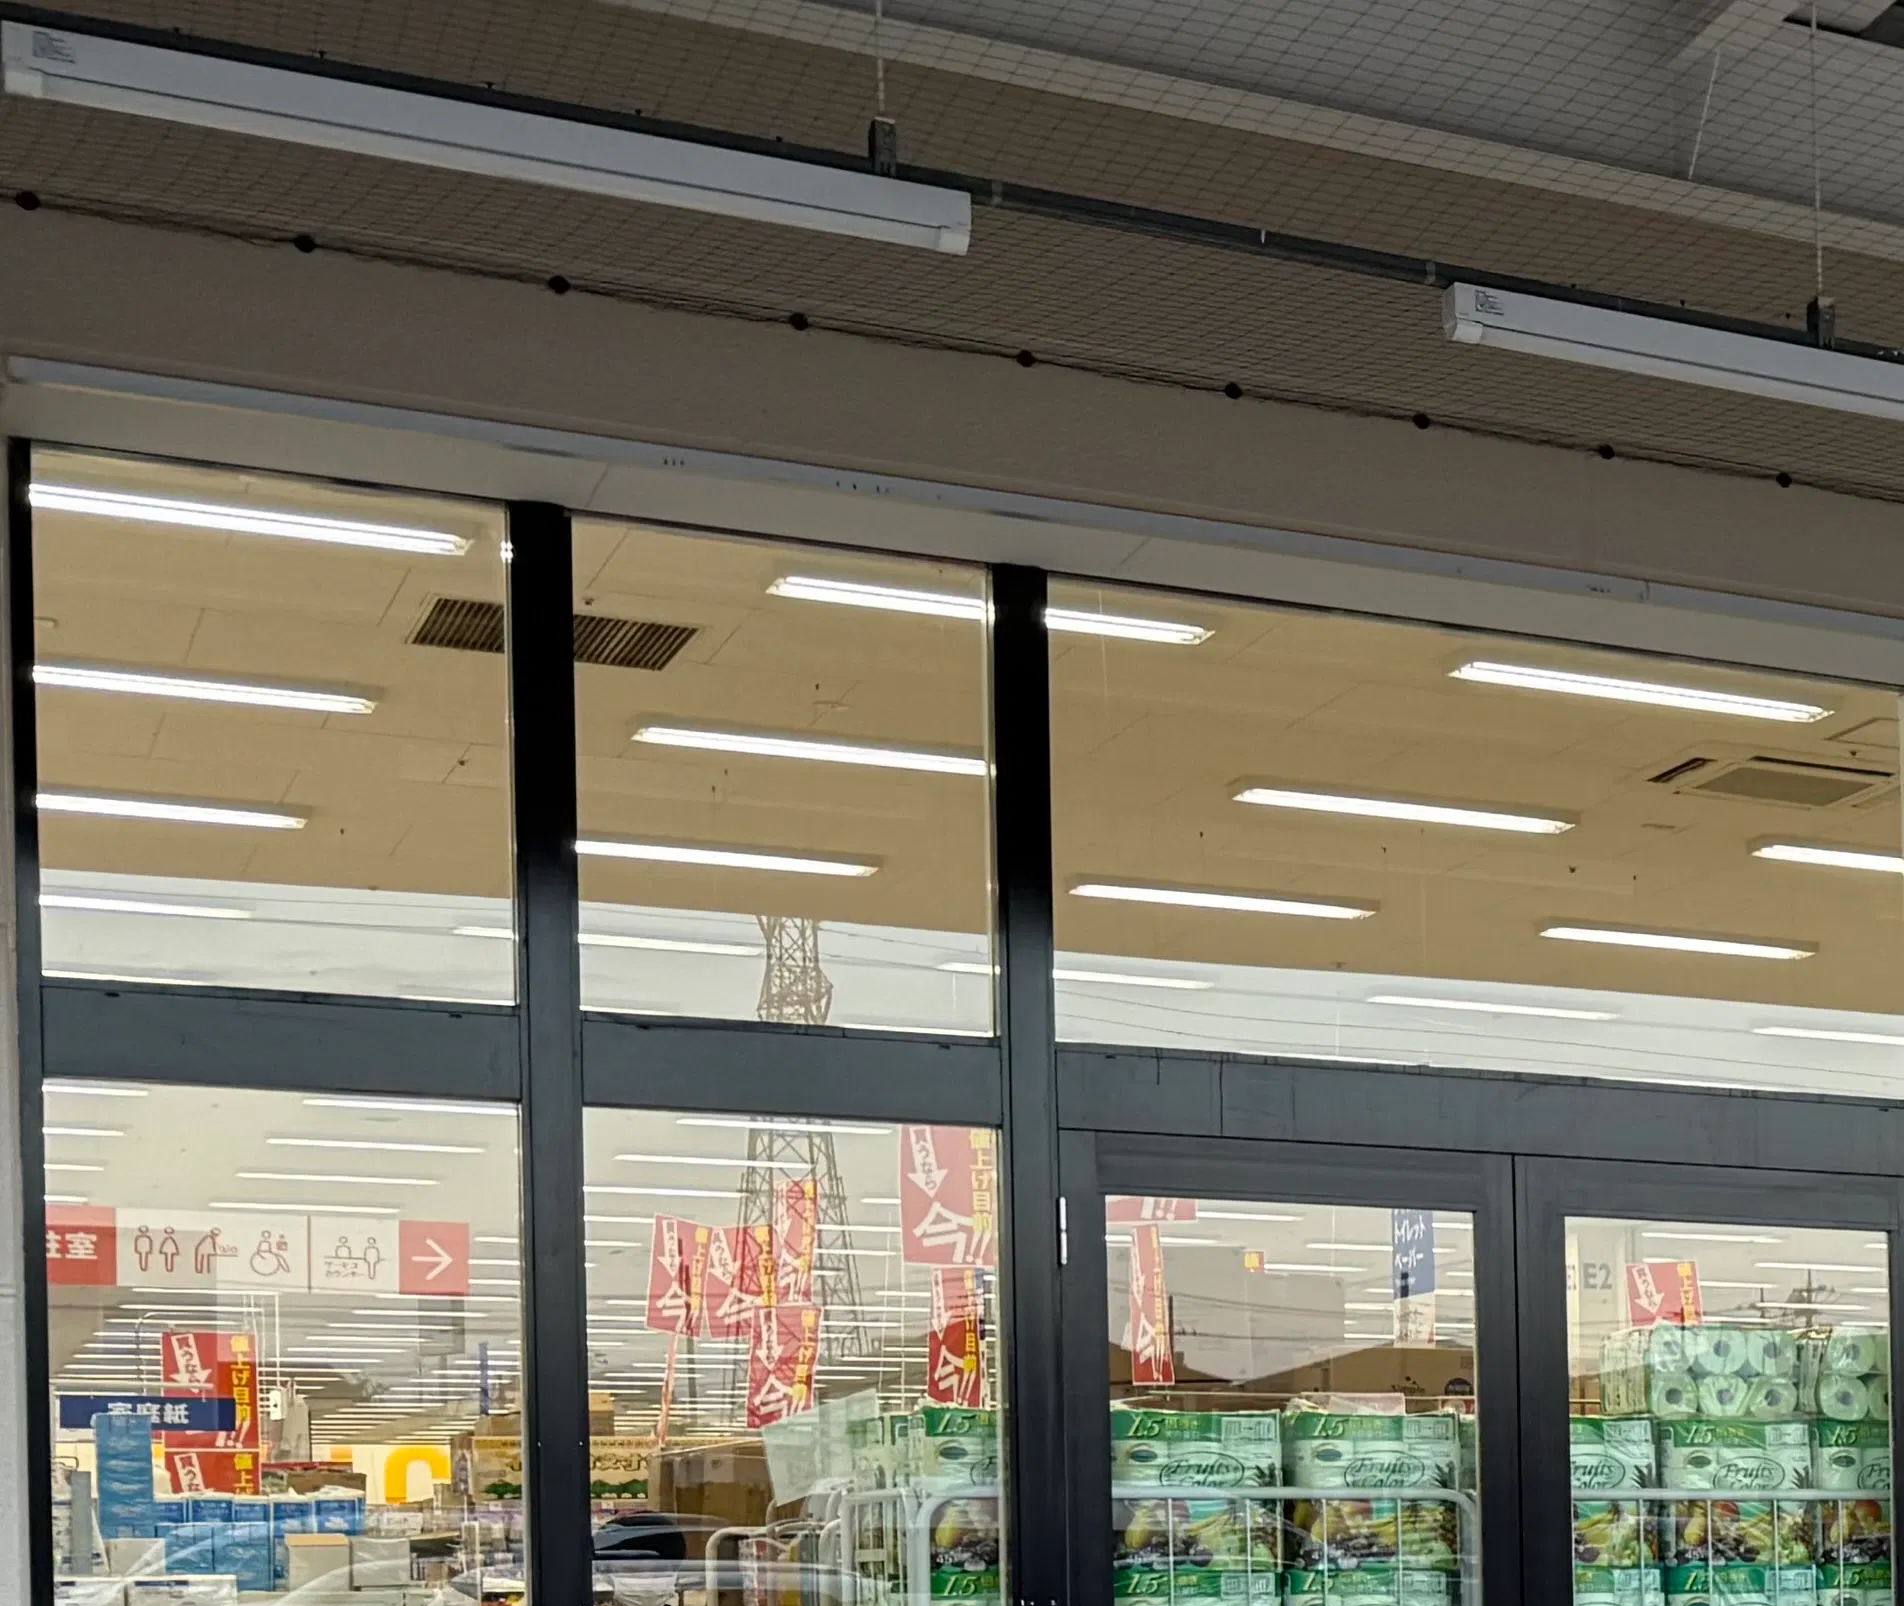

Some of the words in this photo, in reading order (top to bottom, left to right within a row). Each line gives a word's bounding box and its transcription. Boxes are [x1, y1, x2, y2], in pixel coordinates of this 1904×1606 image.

[1582, 1262, 1614, 1290] E2
[937, 1413, 975, 1435] 1.5
[1127, 1414, 1161, 1437] 1.5
[1311, 1415, 1347, 1437] 1.5
[1169, 1456, 1232, 1478] Fruits
[1349, 1455, 1414, 1478] Fruits
[1724, 1464, 1775, 1482] Fruits
[942, 1574, 978, 1597] 1.5
[1127, 1571, 1161, 1594] 1.5
